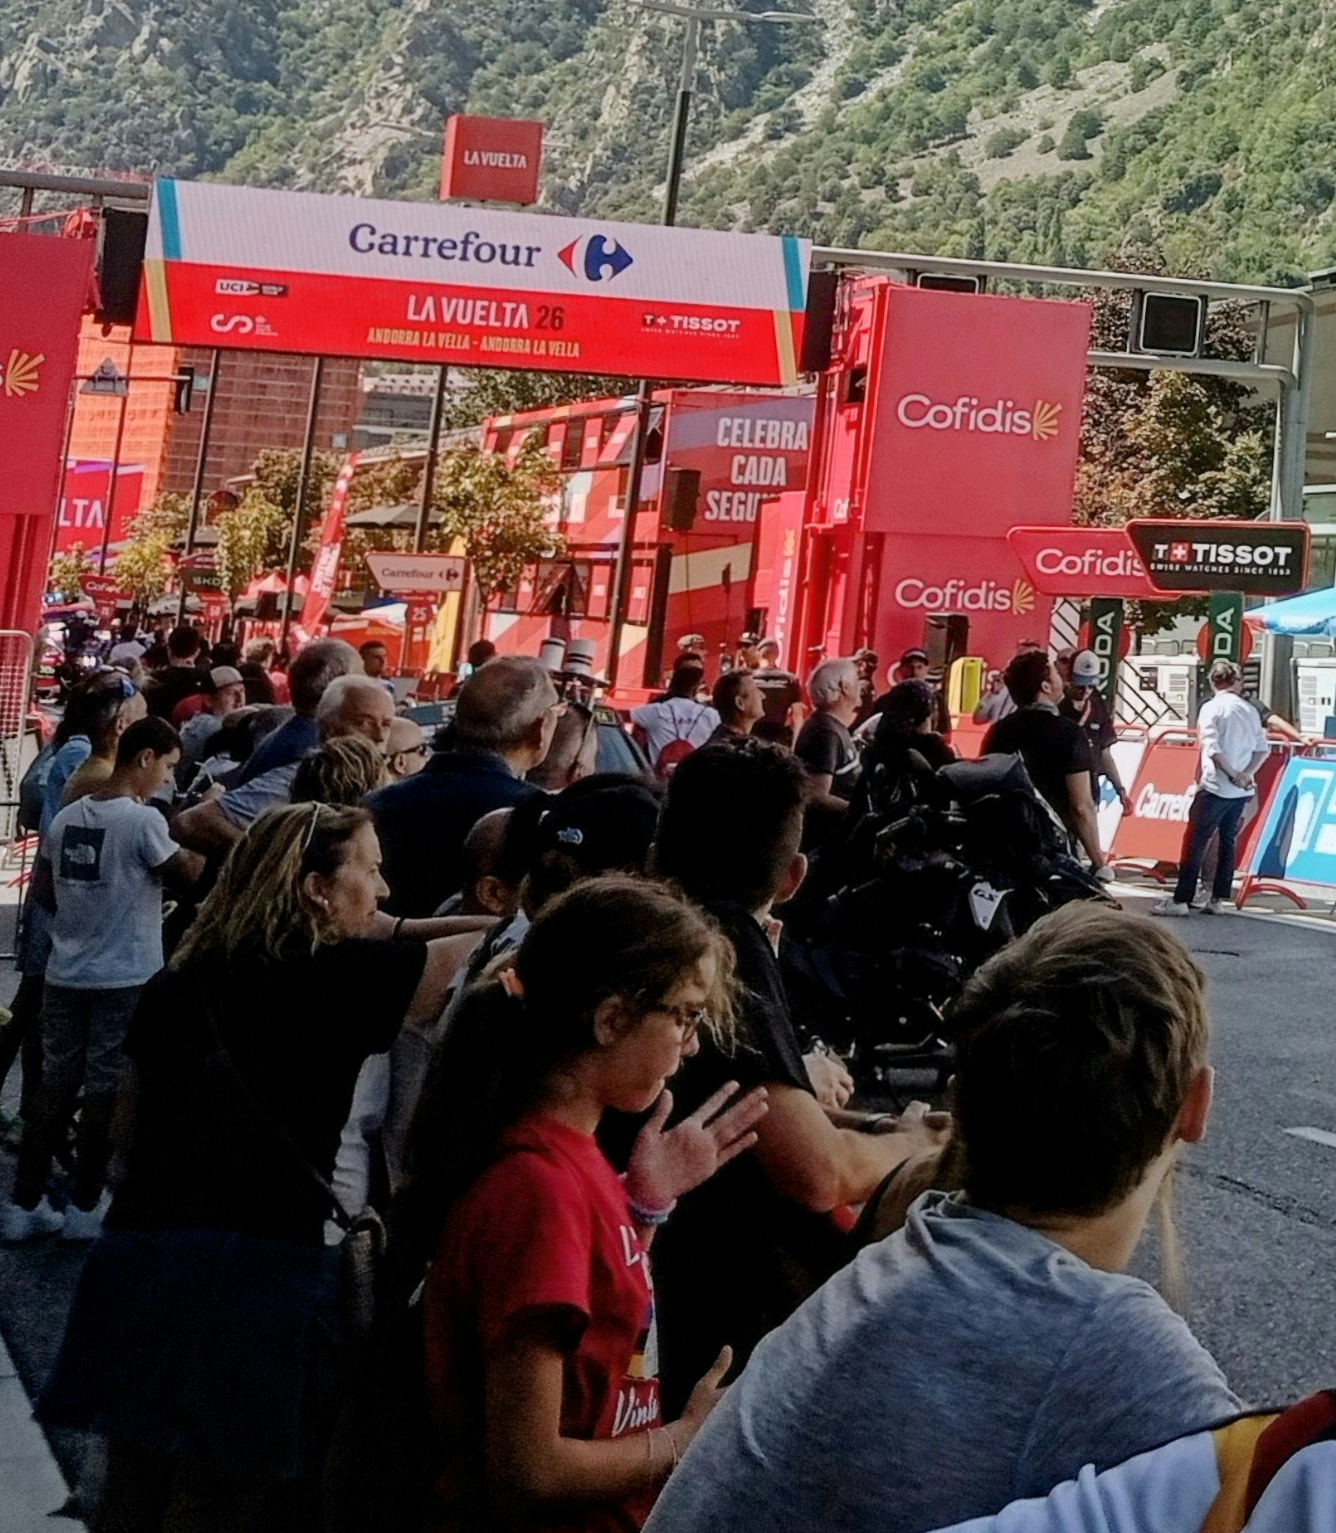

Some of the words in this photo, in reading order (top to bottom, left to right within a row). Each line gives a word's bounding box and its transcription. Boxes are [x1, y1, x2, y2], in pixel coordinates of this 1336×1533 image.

[464, 149, 479, 165] LA
[481, 151, 527, 168] VUELTA
[349, 223, 542, 267] Carrefour
[220, 282, 244, 292] UCI
[406, 295, 436, 322] LA
[441, 297, 529, 329] VUELTA
[534, 304, 565, 331] 26
[669, 315, 741, 333] TISSOT
[367, 327, 420, 347] ANDORRA
[422, 331, 437, 348] LA
[438, 332, 471, 351] VELLA
[480, 335, 531, 356] ANDORRA
[533, 339, 546, 356] LA
[547, 341, 580, 359] VELLA
[897, 393, 1032, 436] Cofidis
[717, 416, 808, 451] CELEBRA
[731, 454, 787, 486] CADA
[1150, 562, 1180, 571] SWISS
[1184, 564, 1230, 574] WATCHES
[1234, 566, 1263, 575] SINCE
[1192, 542, 1292, 566] TISSOT
[381, 568, 434, 579] Carrefour
[895, 578, 1011, 611] Cofidis
